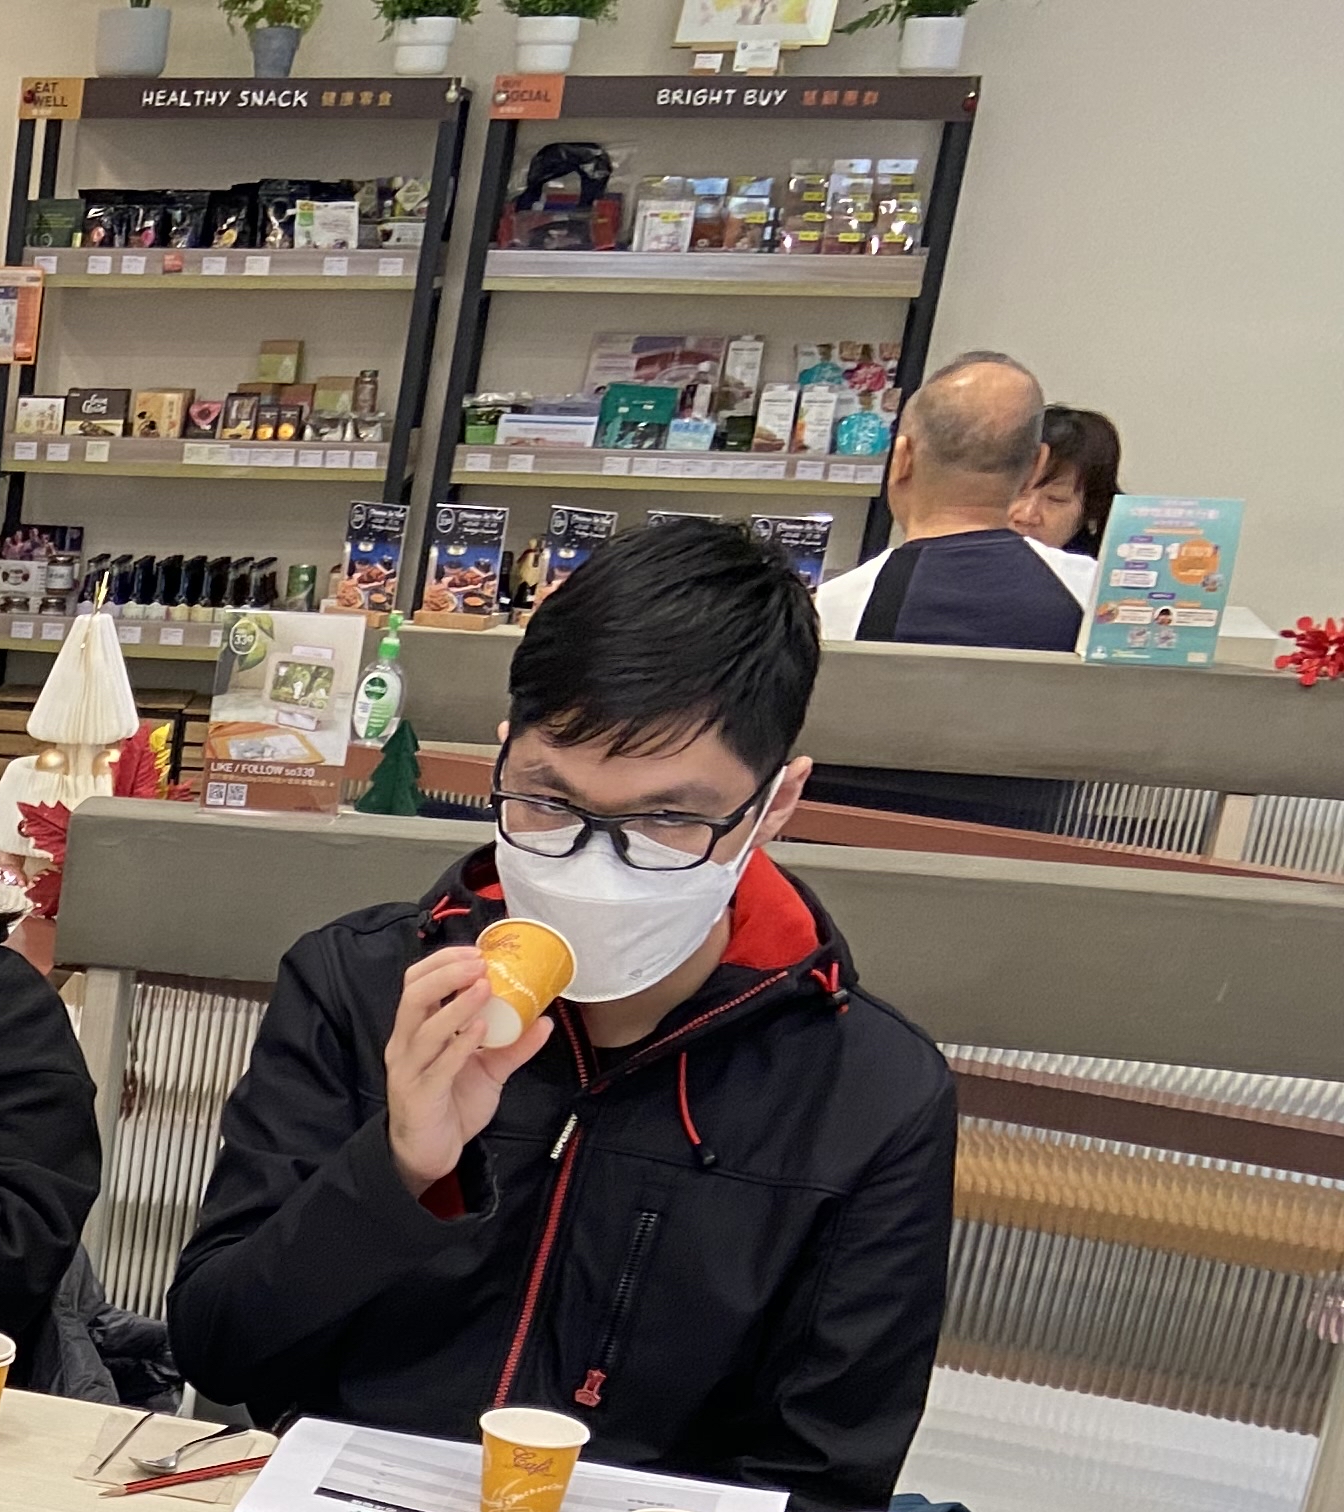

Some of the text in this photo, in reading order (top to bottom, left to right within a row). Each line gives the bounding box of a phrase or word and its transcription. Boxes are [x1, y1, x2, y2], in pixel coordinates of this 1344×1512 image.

[34, 81, 60, 93] EAT
[141, 89, 231, 107] HEALTHY
[237, 89, 308, 107] SNACK
[656, 88, 737, 106] BRIGHT
[743, 88, 788, 106] BUY
[210, 761, 233, 773] LIKE
[241, 763, 285, 776] FOLLOW
